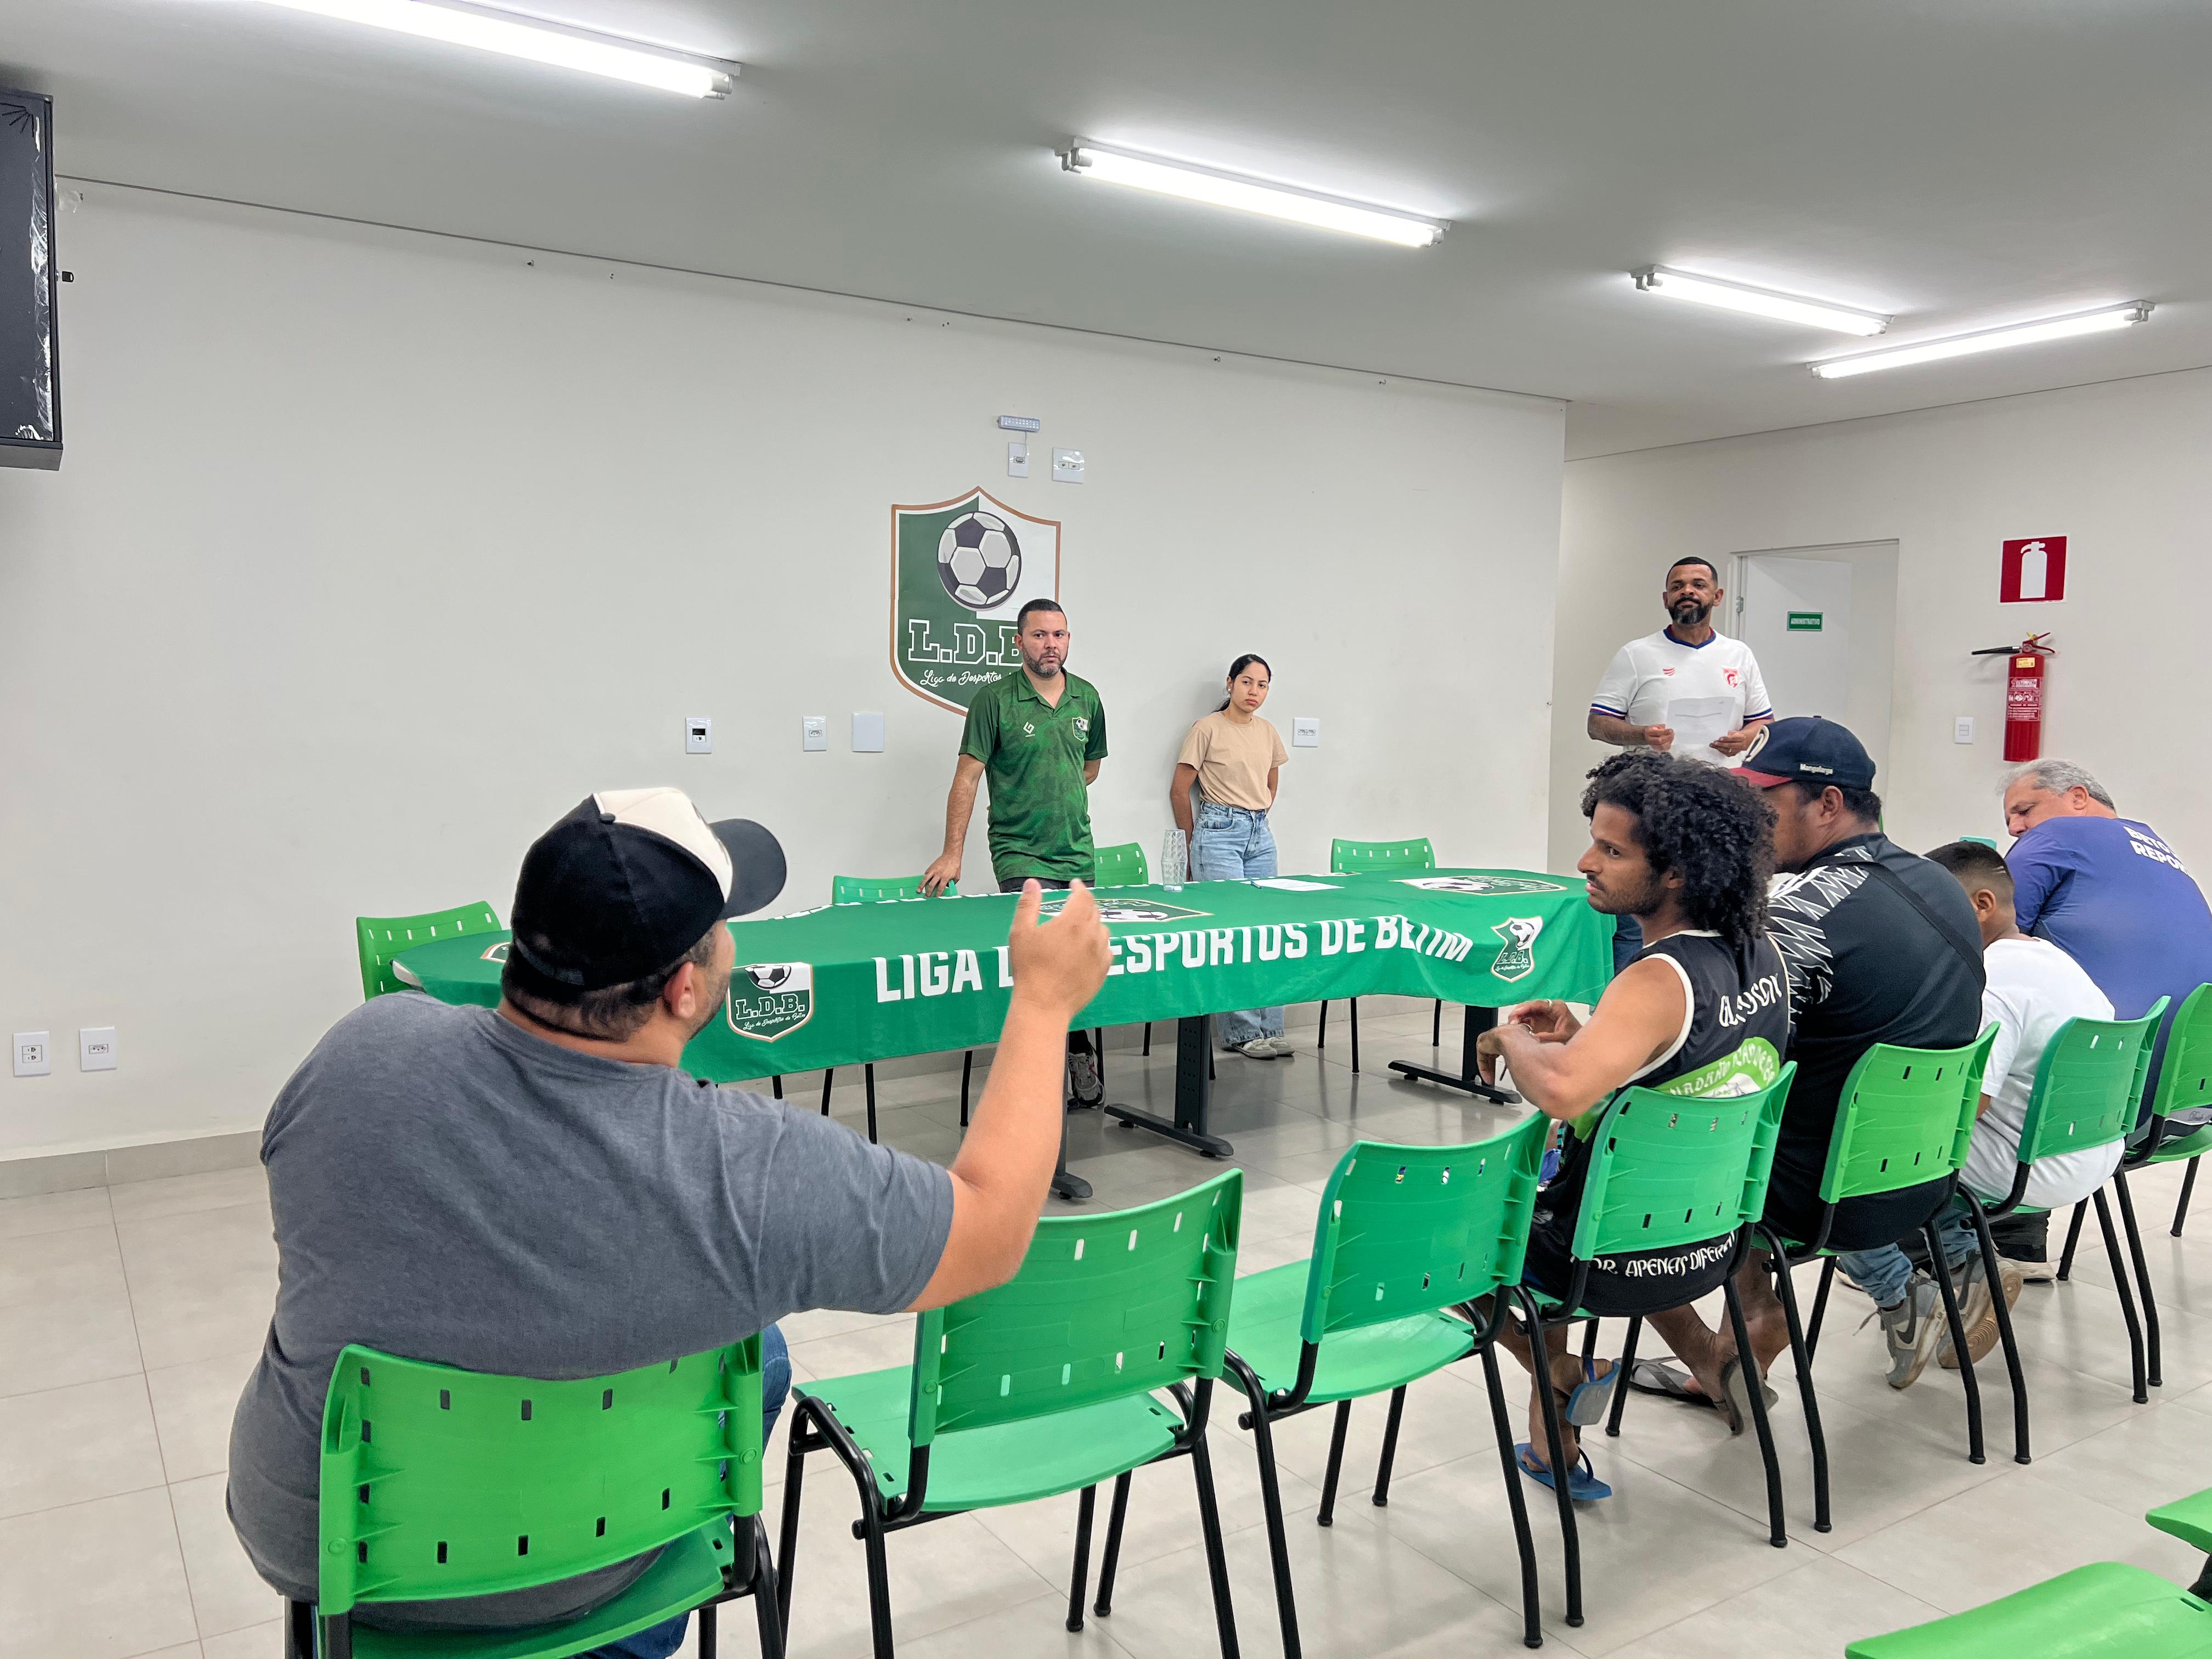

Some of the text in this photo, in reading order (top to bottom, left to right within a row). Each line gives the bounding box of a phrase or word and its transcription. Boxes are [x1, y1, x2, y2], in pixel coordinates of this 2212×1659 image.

[920, 669, 1002, 687] Liga de Desportos
[2130, 840, 2191, 876] REPOR
[871, 949, 983, 1003] LIGA
[1106, 922, 1308, 976] ESPORTOS
[1312, 918, 1366, 956] DE
[735, 994, 805, 1020] L.D.B.
[1625, 1255, 1688, 1277] APENAS
